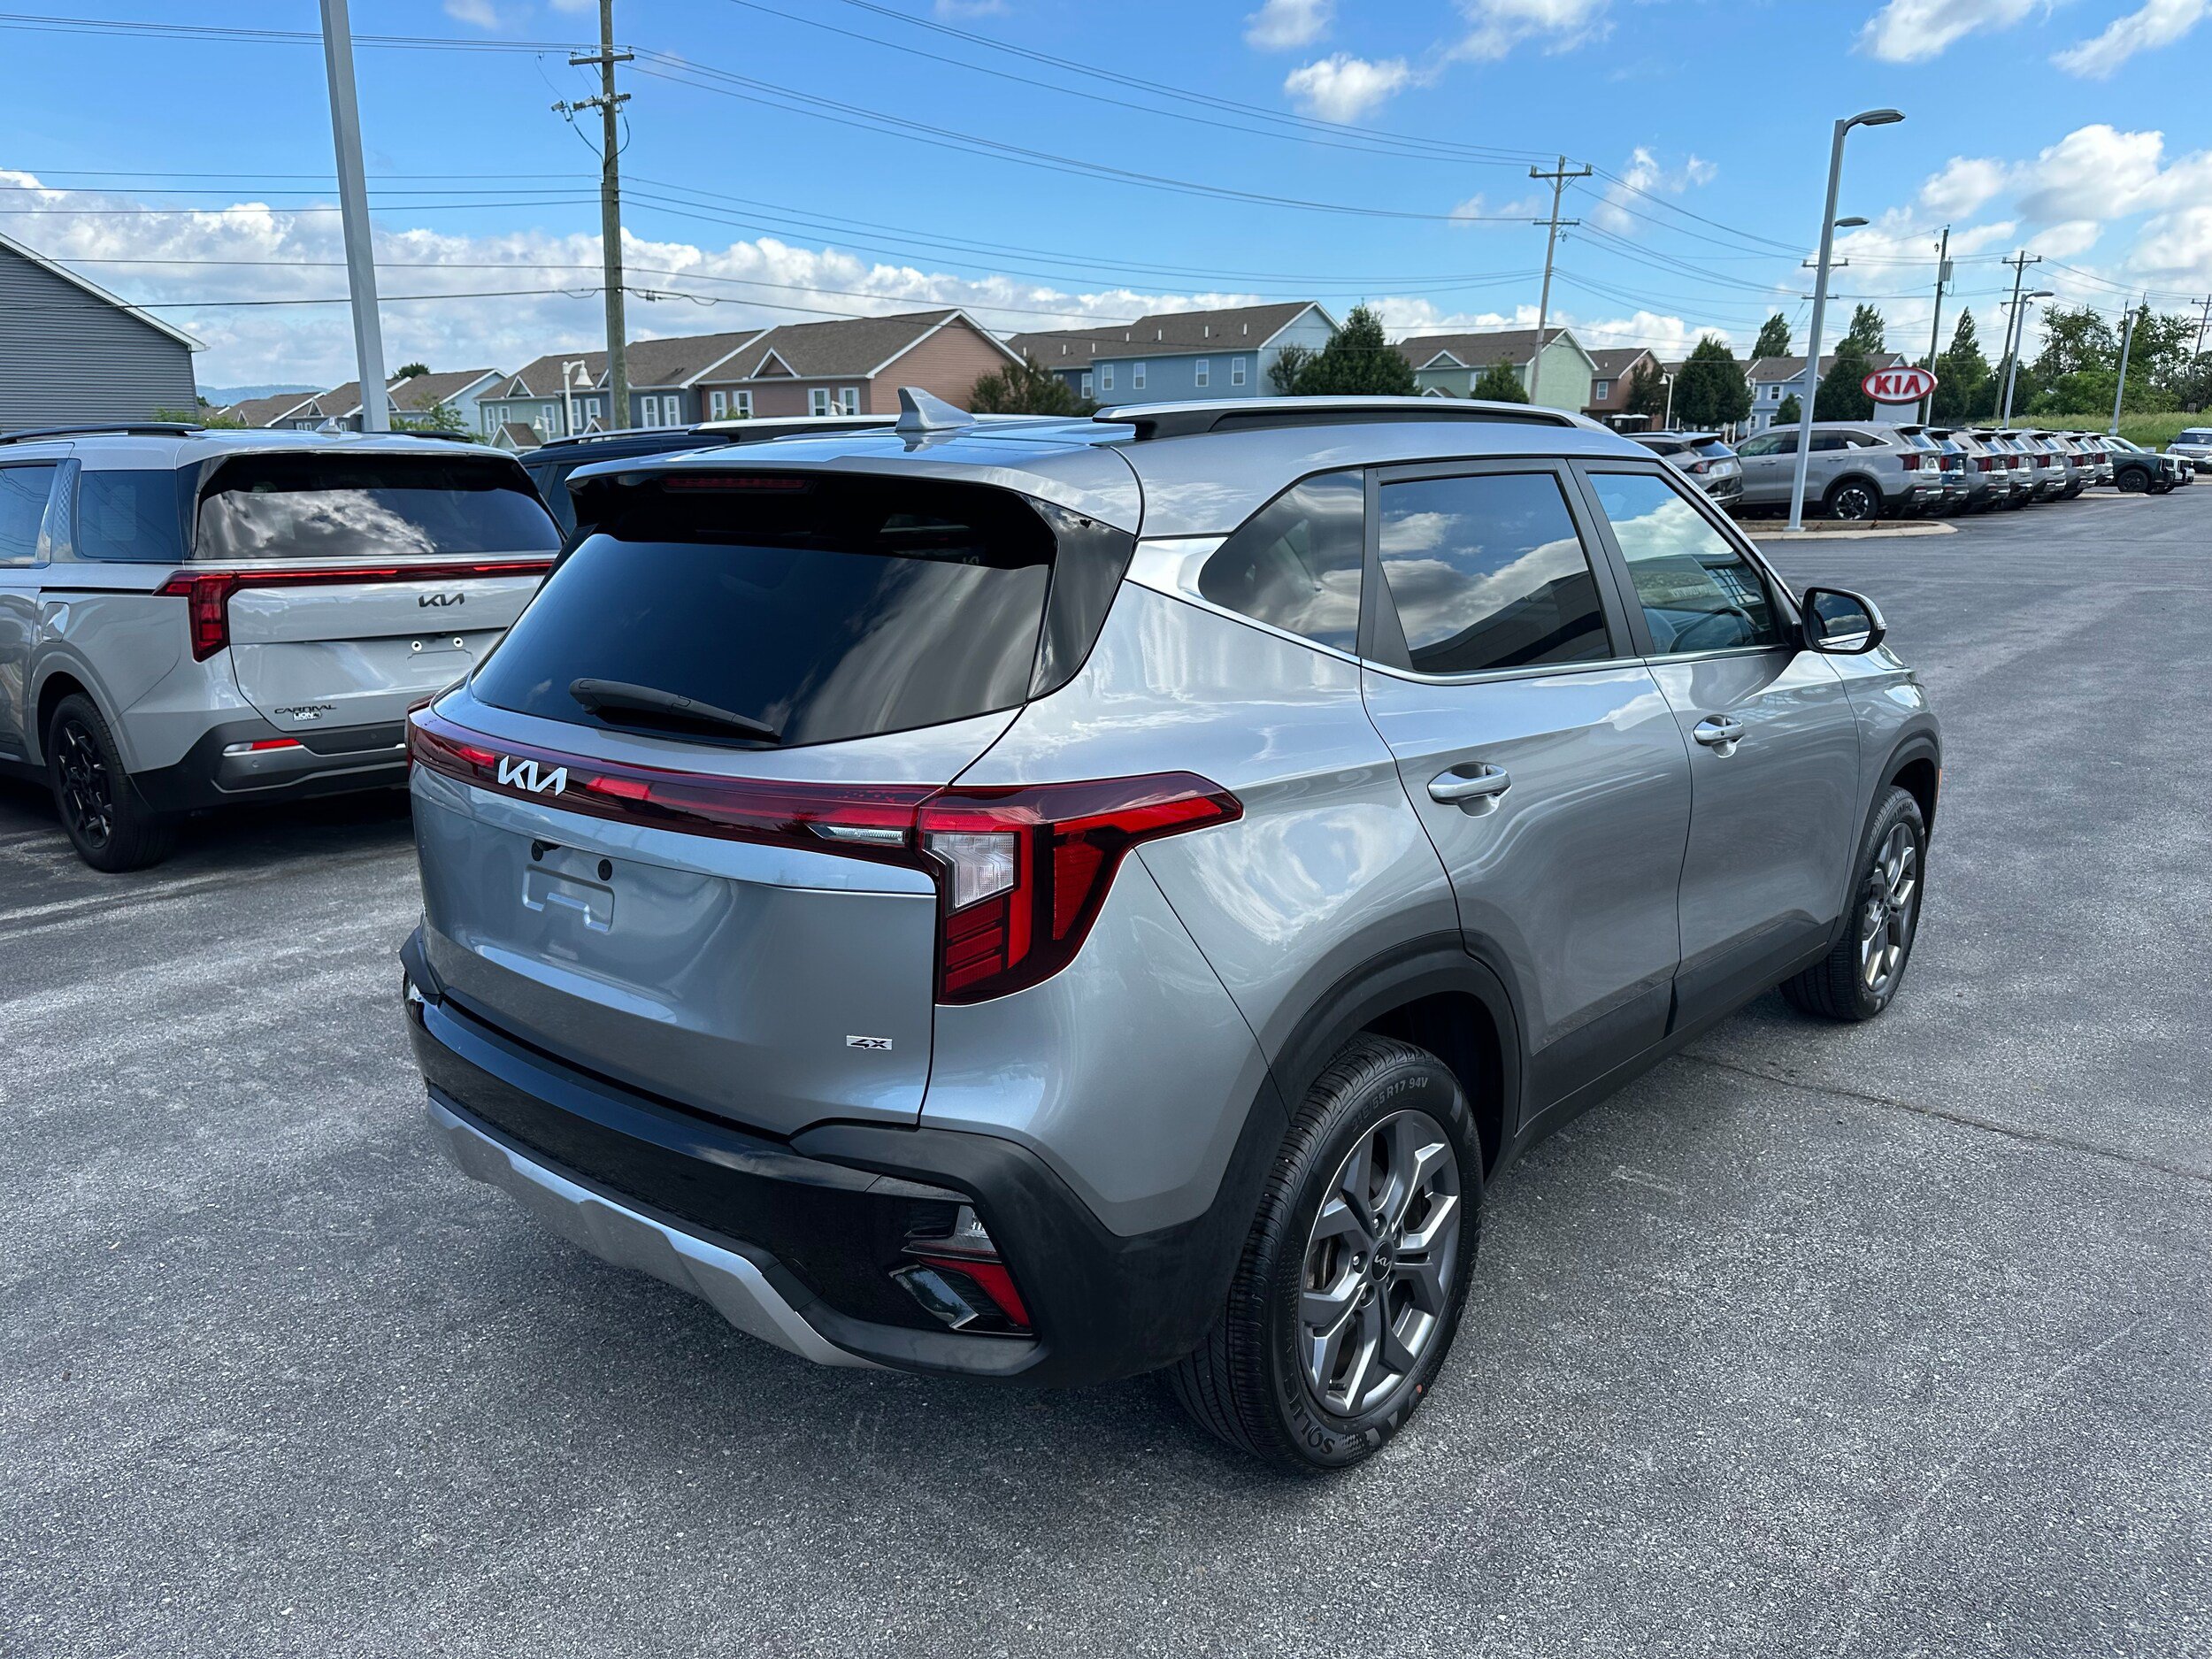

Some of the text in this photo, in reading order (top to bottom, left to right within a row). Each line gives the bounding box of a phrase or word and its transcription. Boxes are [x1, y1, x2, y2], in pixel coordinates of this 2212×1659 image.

[1874, 375, 1921, 395] KIA
[419, 593, 465, 607] KIA
[497, 755, 568, 796] KIA
[1386, 1079, 1407, 1099] R17
[1409, 1077, 1429, 1089] 94V
